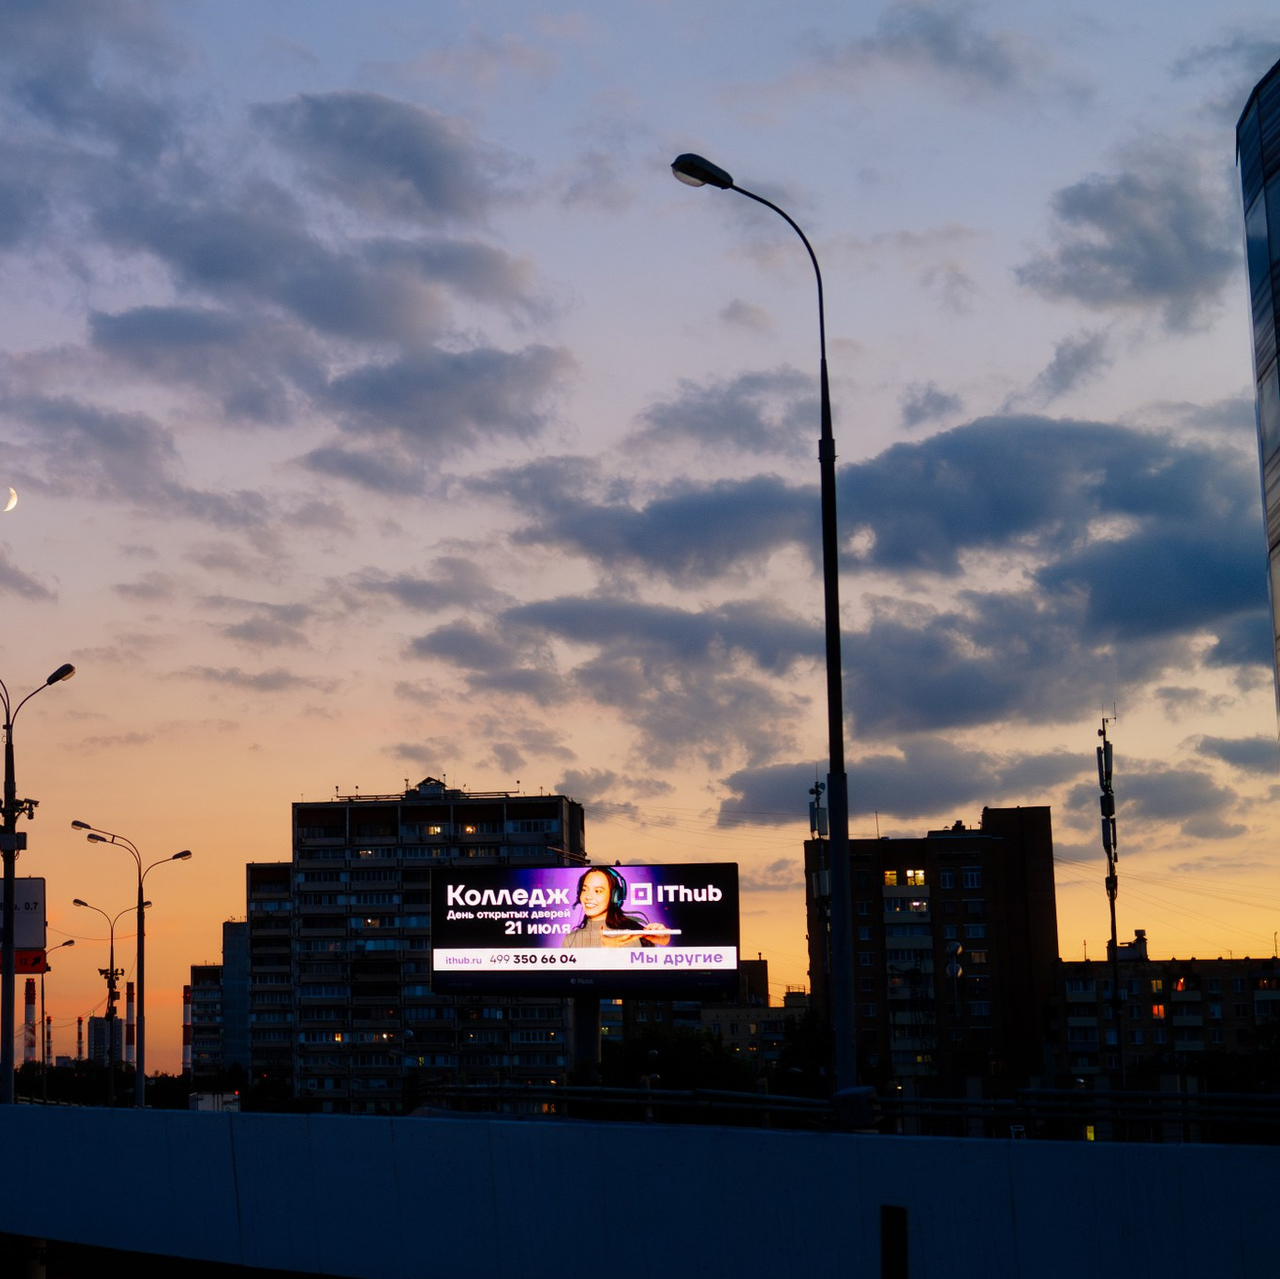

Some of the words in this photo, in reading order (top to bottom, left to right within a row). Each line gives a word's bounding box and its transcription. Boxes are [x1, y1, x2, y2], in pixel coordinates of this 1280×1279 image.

[447, 884, 570, 908] Колледж
[657, 884, 723, 903] IThub
[447, 910, 475, 920] День
[477, 911, 529, 921] открытых
[531, 909, 571, 920] дверей
[505, 921, 522, 935] 21
[527, 924, 571, 935] июля
[445, 956, 483, 965] ithub.ru
[489, 954, 510, 964] 499
[513, 954, 537, 964] 350
[541, 954, 556, 964] 66
[559, 954, 577, 964] 04
[630, 951, 658, 964] Мы
[663, 953, 723, 967] другие
